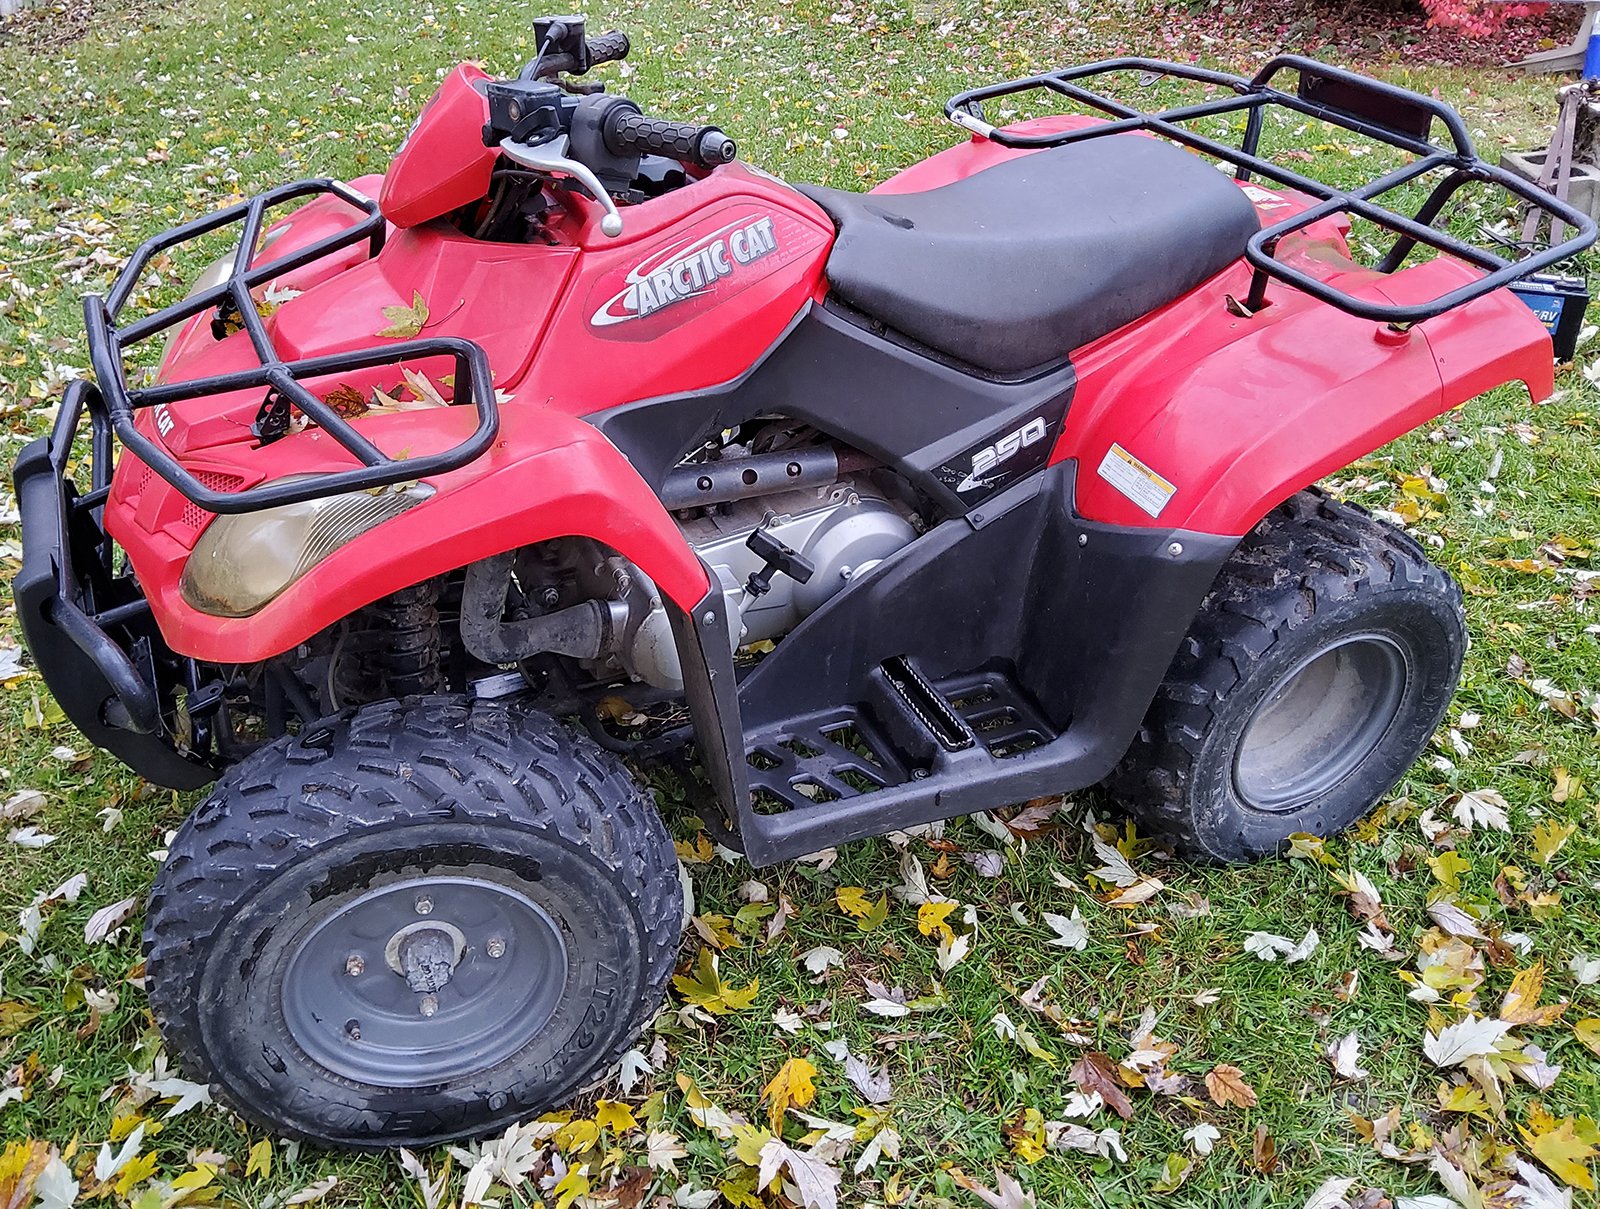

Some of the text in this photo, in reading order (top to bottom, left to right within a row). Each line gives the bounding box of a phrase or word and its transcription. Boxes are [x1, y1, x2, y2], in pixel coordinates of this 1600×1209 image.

[635, 239, 732, 318] ARCTIC
[728, 216, 778, 265] CAT
[971, 416, 1047, 478] 250
